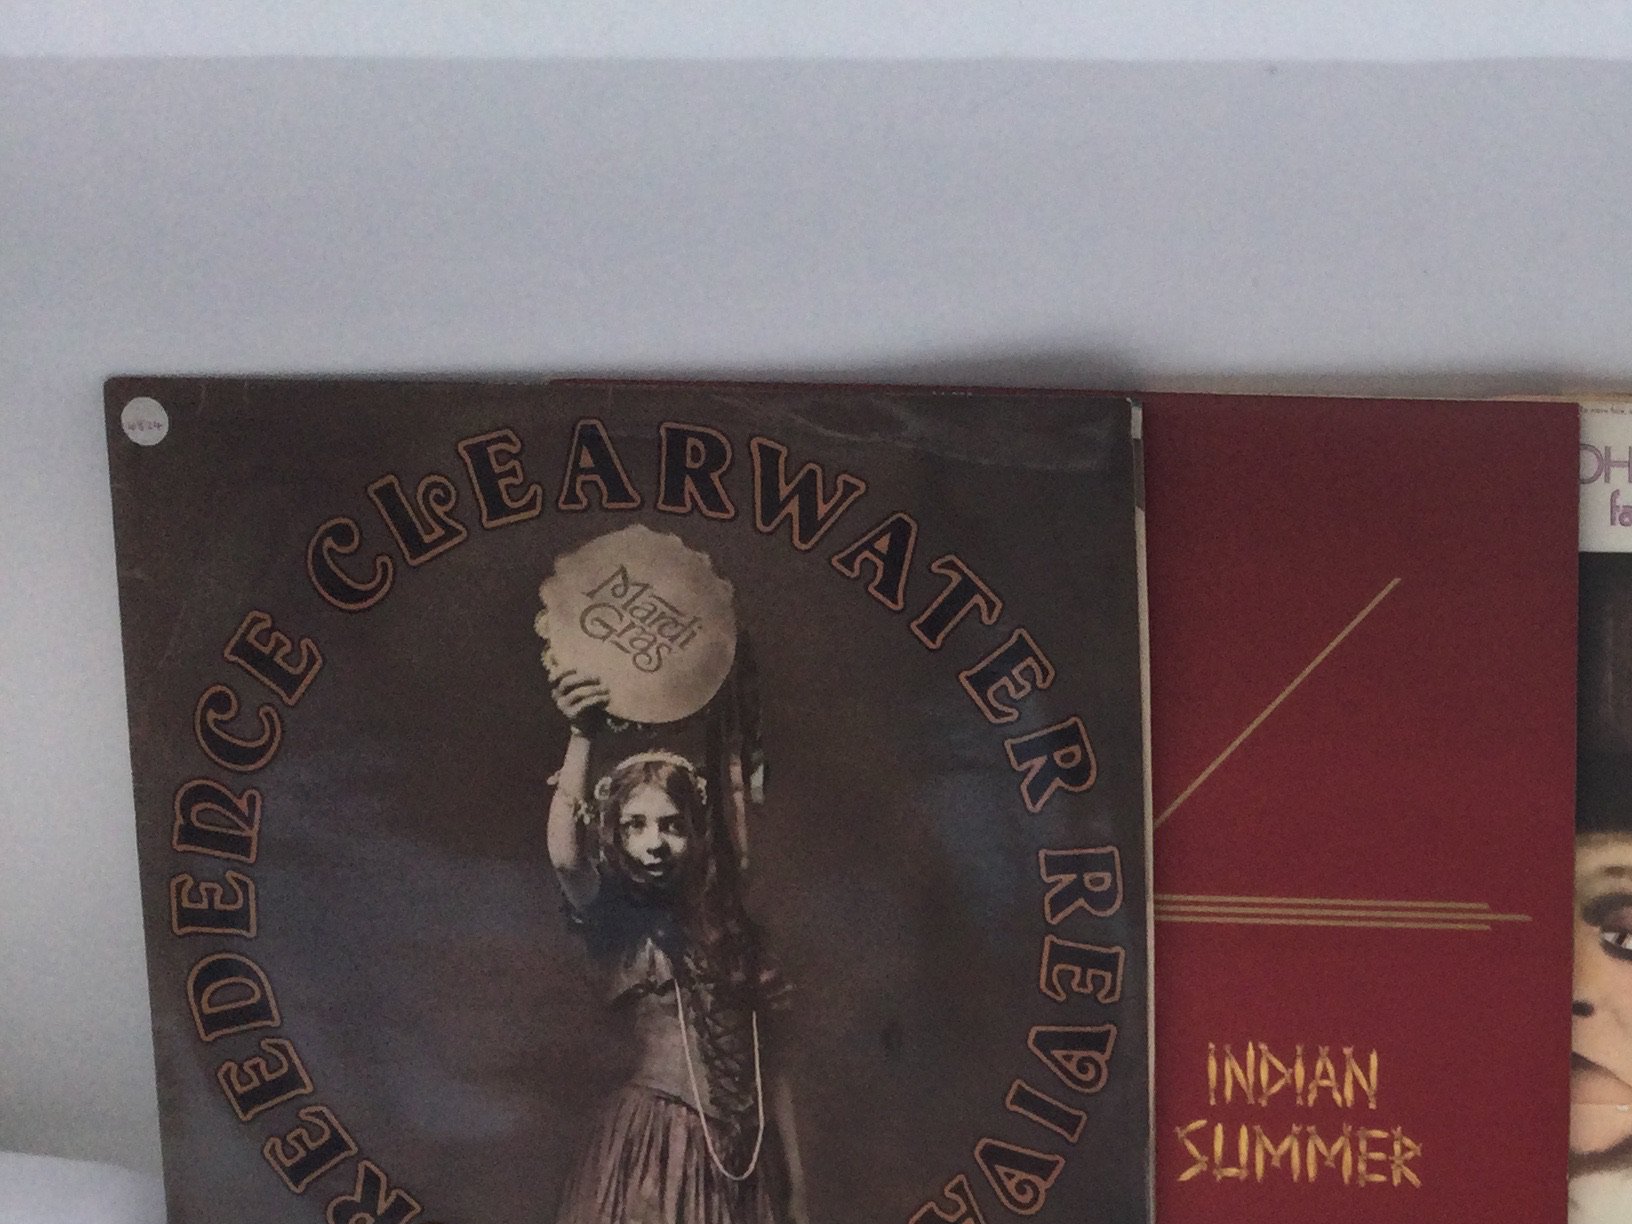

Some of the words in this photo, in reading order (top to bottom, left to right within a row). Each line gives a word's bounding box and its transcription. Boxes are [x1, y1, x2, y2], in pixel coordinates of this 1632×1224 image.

[307, 418, 1098, 813] CLEARWATER
[579, 602, 675, 674] Gras
[1206, 1040, 1379, 1110] INDIAN
[1174, 1119, 1424, 1189] SUMMER
